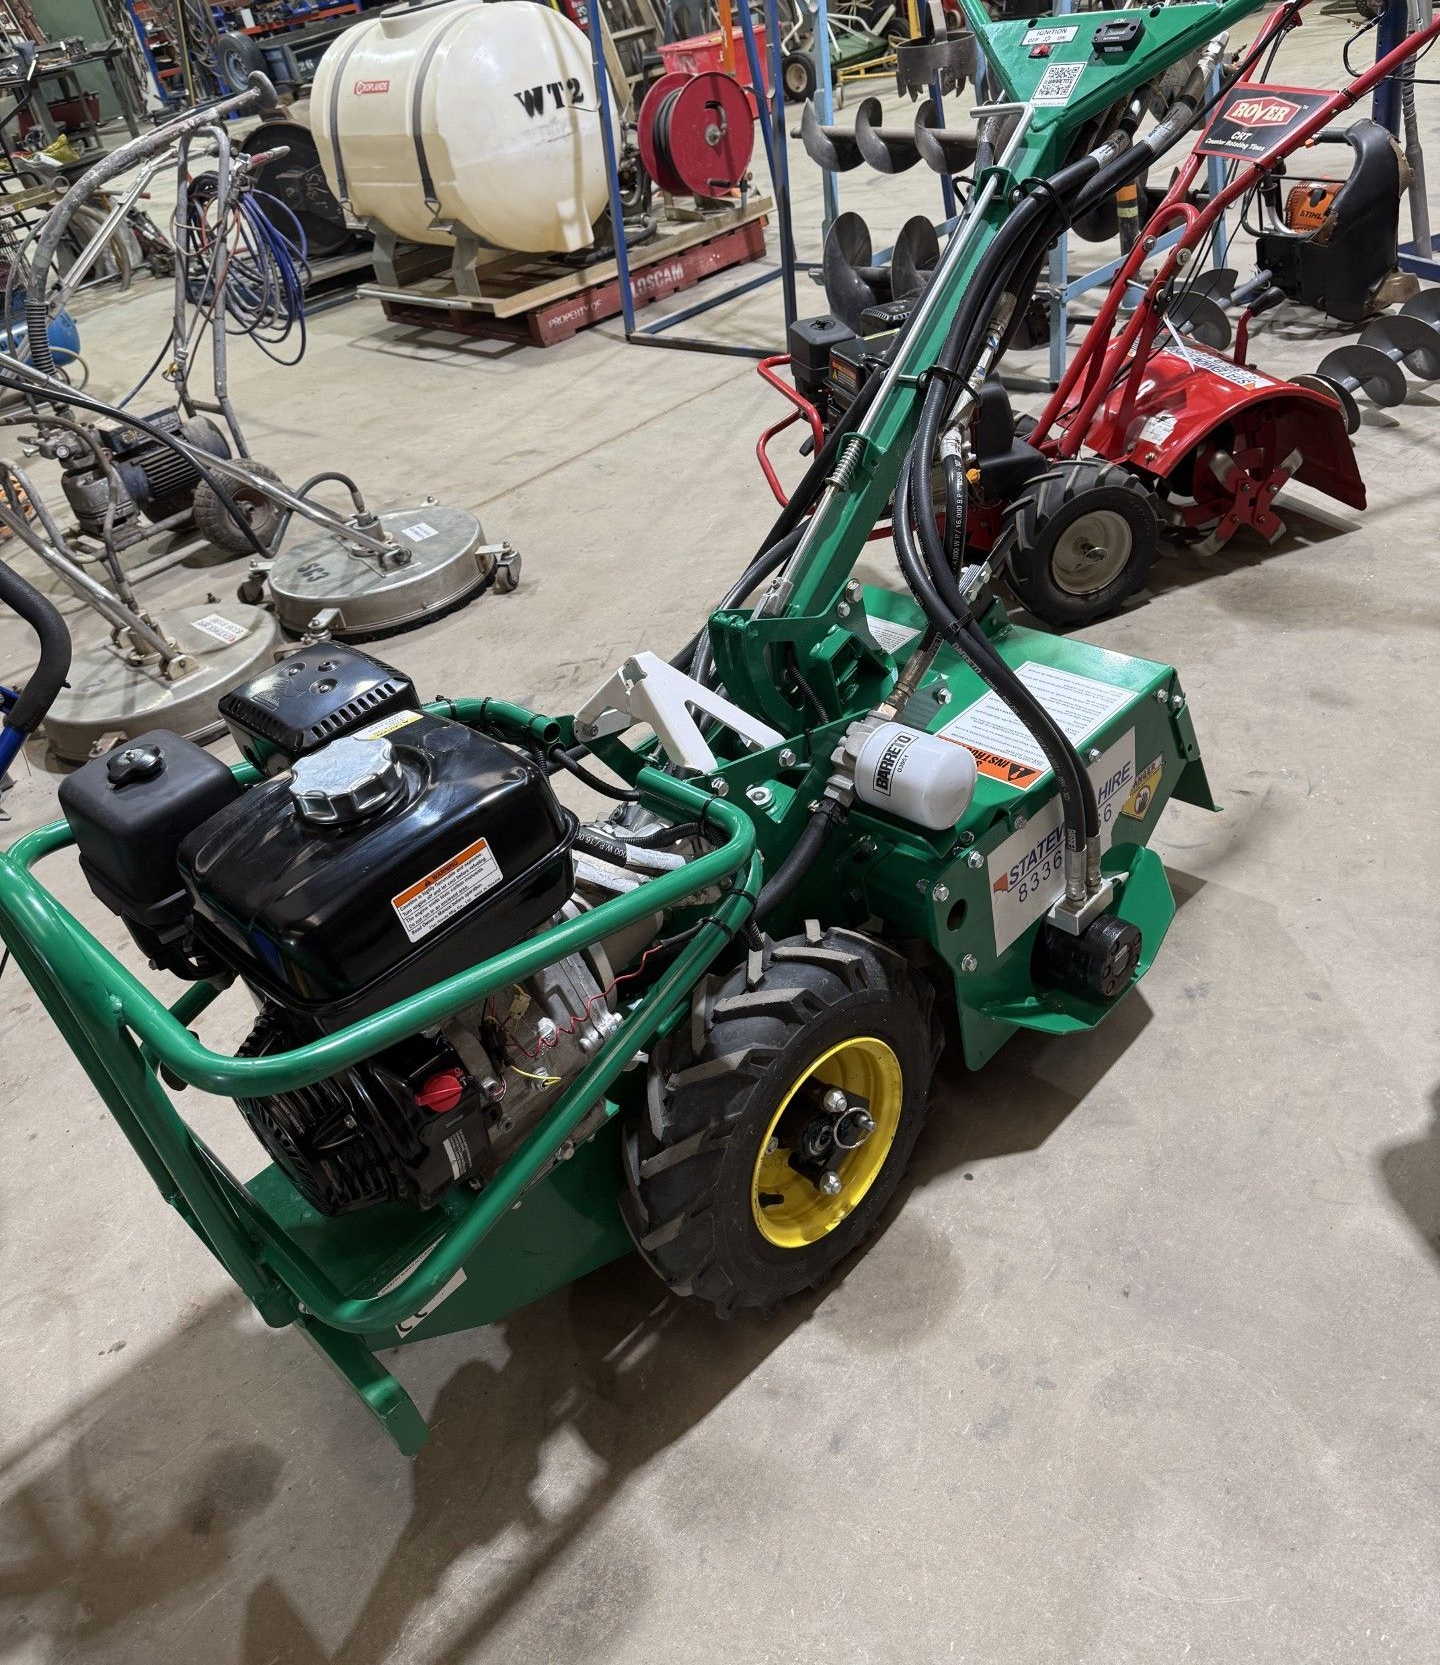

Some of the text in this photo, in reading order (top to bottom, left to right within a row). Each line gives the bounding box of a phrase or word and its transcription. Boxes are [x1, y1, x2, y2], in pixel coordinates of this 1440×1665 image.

[1037, 28, 1067, 36] IGNITION
[514, 77, 585, 118] WT2
[1231, 100, 1290, 124] ROVER
[1205, 137, 1225, 146] Counter
[1225, 139, 1248, 151] Rotating
[1231, 131, 1252, 141] CRT
[1300, 210, 1322, 220] STIHL
[630, 263, 684, 299] LOSCAM
[549, 306, 590, 329] PROPERTY
[876, 735, 912, 791] BARRETO
[967, 747, 1010, 768] INSTRU
[1009, 760, 1131, 886] STATEW HIRE
[431, 860, 458, 880] WARNING
[1019, 850, 1062, 903] 8336
[399, 897, 418, 911] Gasoline
[420, 885, 435, 896] highly
[434, 871, 456, 886] flammable
[402, 908, 412, 917] Turn
[412, 898, 427, 910] engine
[446, 877, 456, 885] cool
[455, 868, 469, 879] before
[439, 891, 458, 905] enclosed
[405, 915, 415, 923] The
[413, 906, 428, 917] engine
[411, 926, 422, 934] Read
[437, 904, 452, 916] Manual
[451, 895, 464, 905] before
